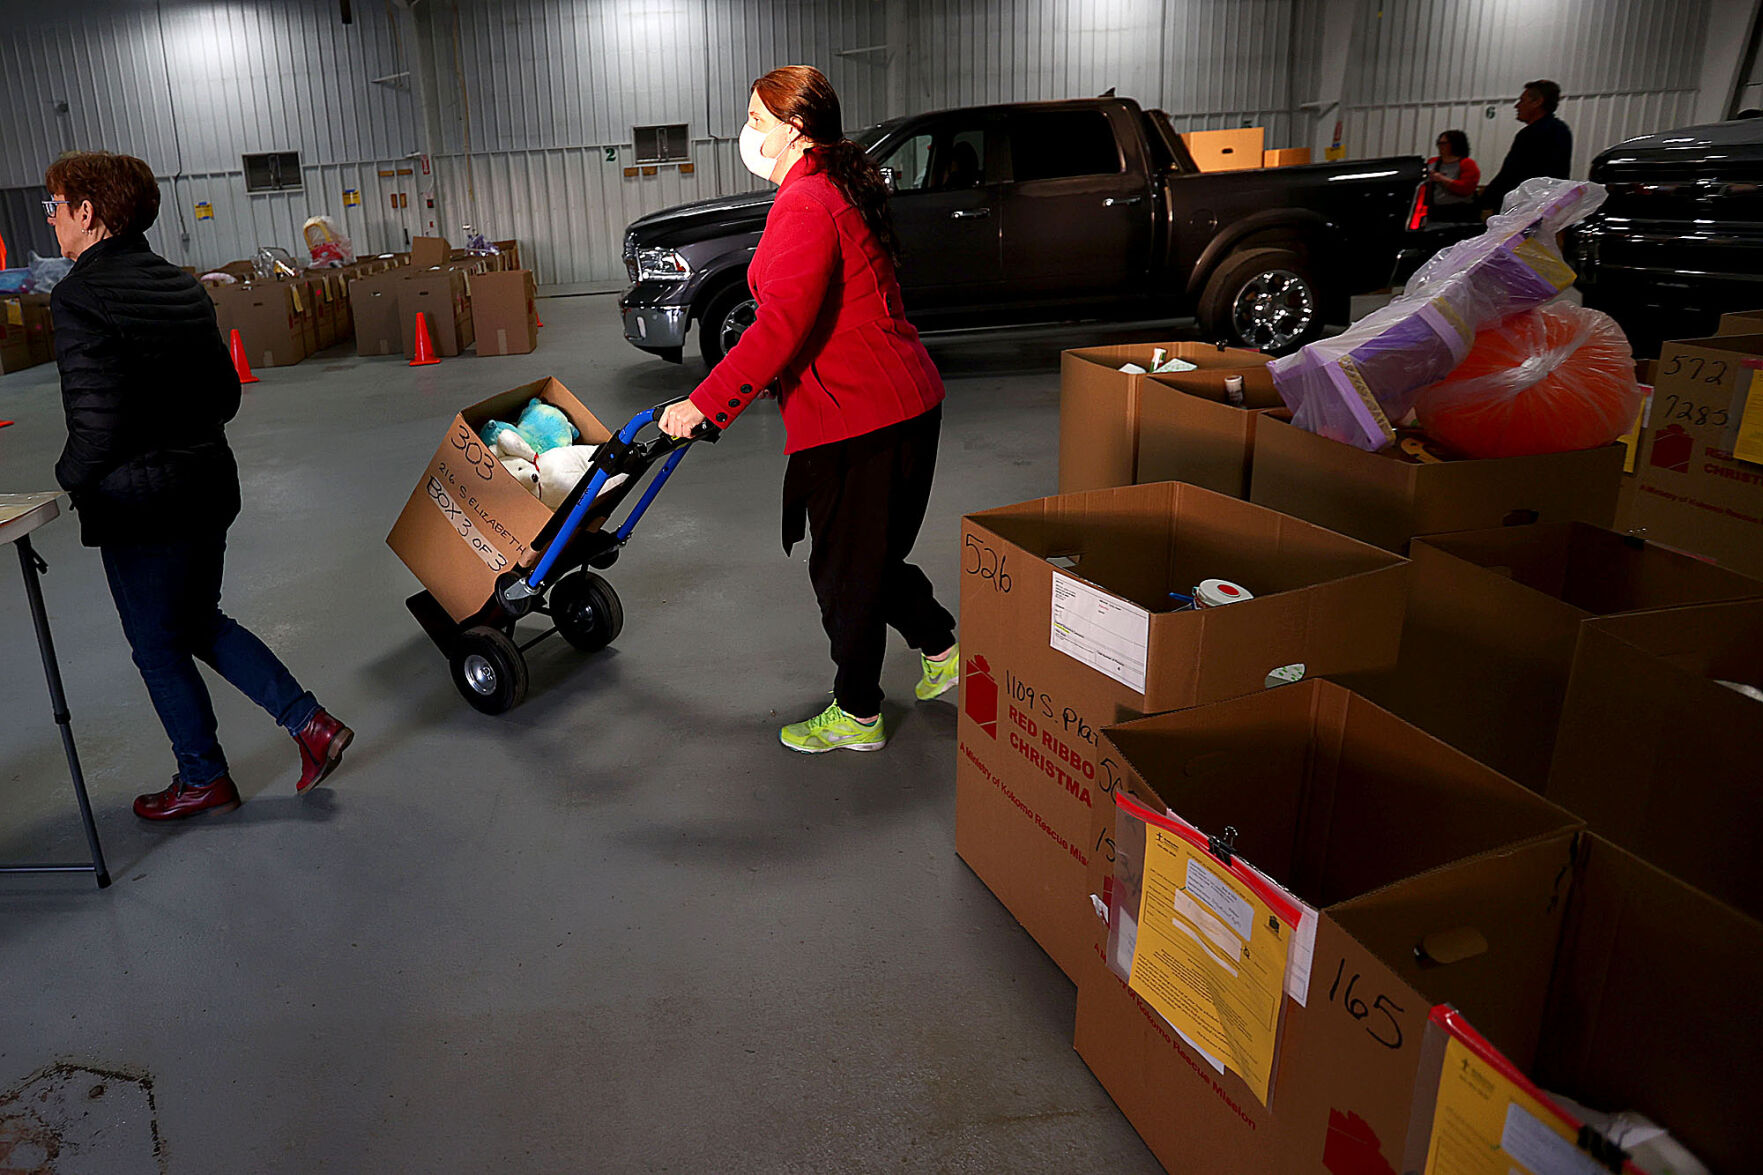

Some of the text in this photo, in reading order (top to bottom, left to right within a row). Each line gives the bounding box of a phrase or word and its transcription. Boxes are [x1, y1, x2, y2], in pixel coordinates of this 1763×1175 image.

[1485, 105, 1496, 120] 6
[605, 147, 617, 162] 2
[1664, 355, 1727, 385] 572
[1664, 394, 1728, 426] 7285
[451, 424, 496, 481] 303
[1704, 464, 1763, 487] CHRIST
[426, 475, 509, 572] BOX 3 OF 3
[438, 461, 527, 555] 216 S ELIZABETH
[965, 533, 1012, 593] 526
[1006, 669, 1035, 709] 1109
[1009, 704, 1096, 780] RED RIBBO
[1009, 731, 1093, 809] CHRISTMA
[959, 742, 1089, 867] A Ministry of Kokomo Rescue Mis
[1328, 957, 1405, 1050] 165
[1136, 1000, 1172, 1044] Kokomo
[1173, 1040, 1211, 1085] Rescue
[1212, 1080, 1257, 1131] Mission
